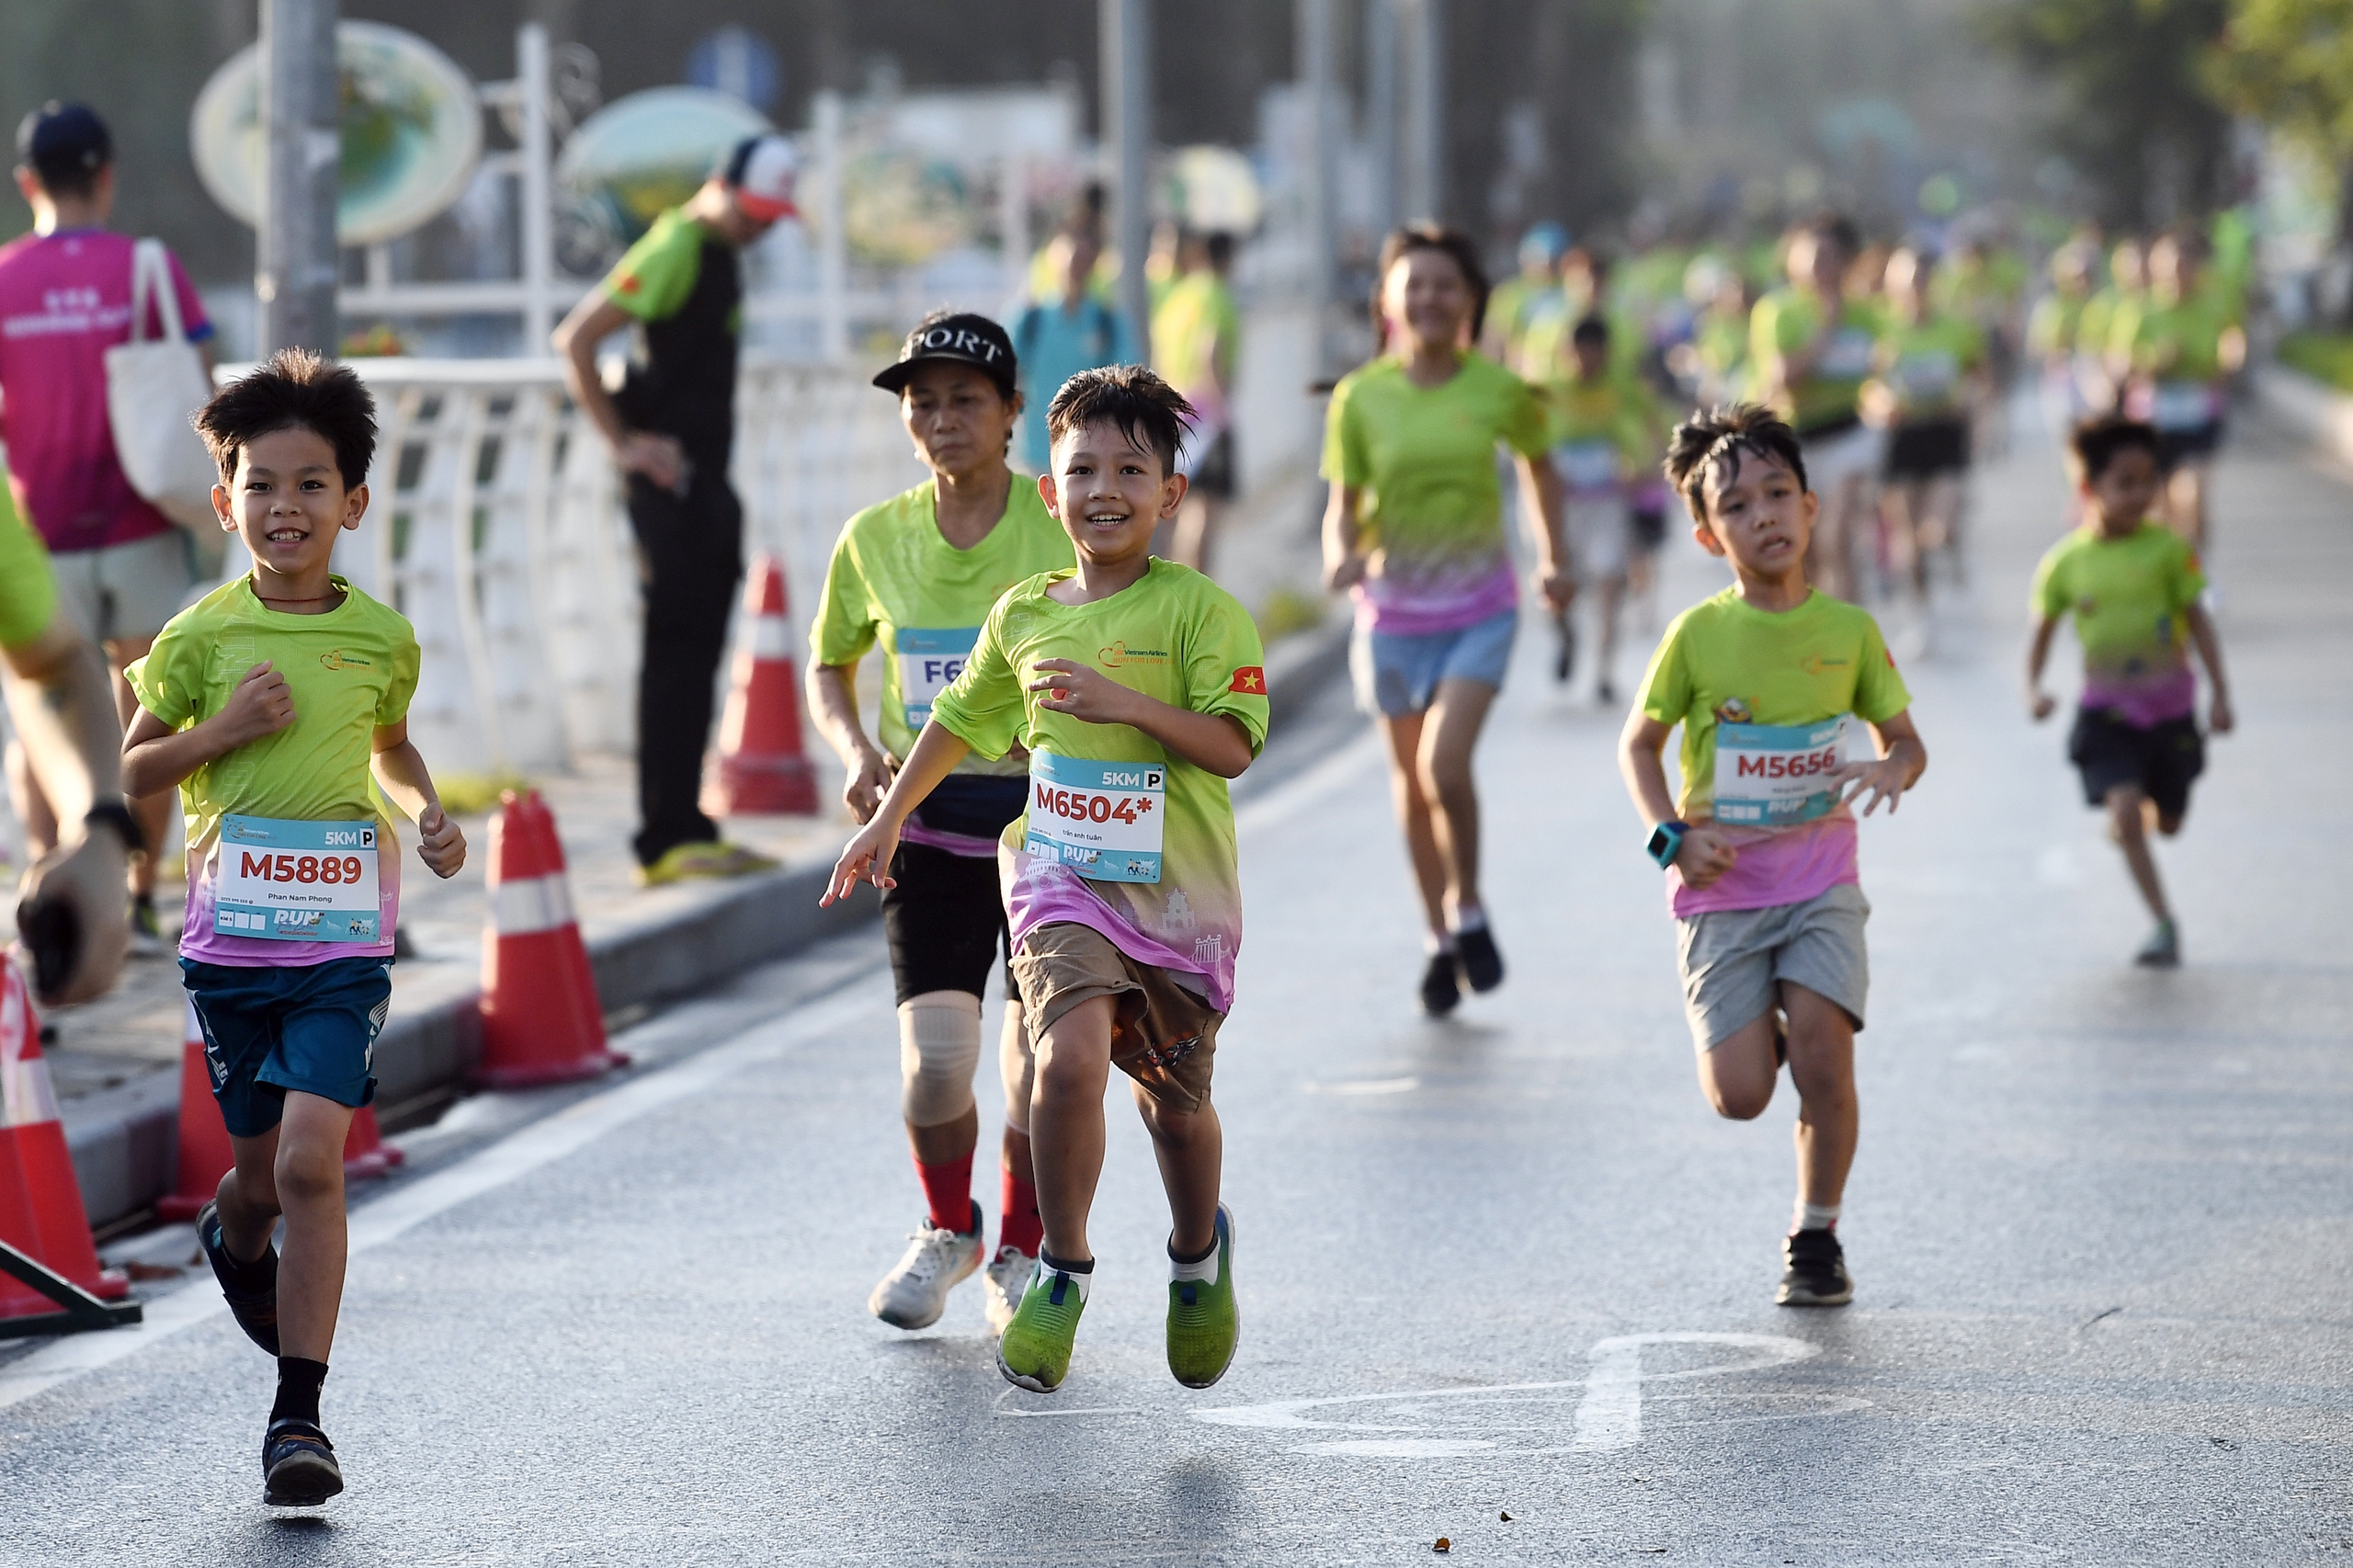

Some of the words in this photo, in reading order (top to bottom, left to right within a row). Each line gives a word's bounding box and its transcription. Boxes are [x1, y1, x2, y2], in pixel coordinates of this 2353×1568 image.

[1737, 745, 1836, 778] M5656
[1102, 771, 1140, 787] 5KM
[1147, 773, 1161, 788] P
[324, 831, 358, 846] 5KM
[362, 831, 373, 846] P
[240, 850, 362, 885] M5889
[267, 892, 288, 902] Phan
[290, 894, 307, 903] Nam
[308, 895, 333, 904] Phong
